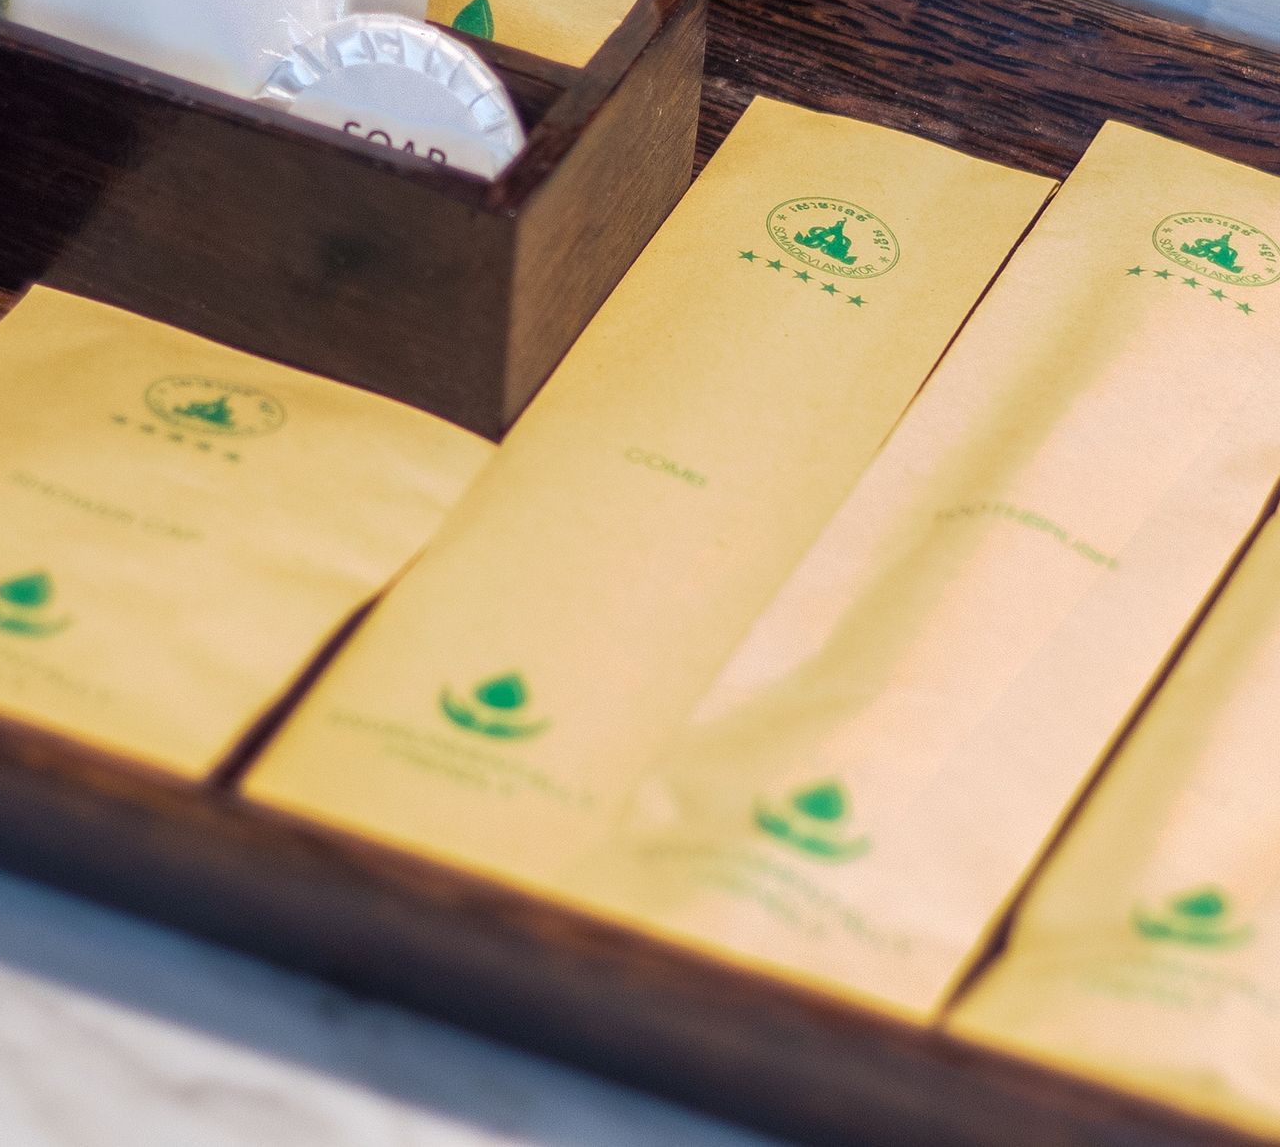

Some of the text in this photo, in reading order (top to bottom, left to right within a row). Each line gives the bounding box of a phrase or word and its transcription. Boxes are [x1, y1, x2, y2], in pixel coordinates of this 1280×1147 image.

[773, 225, 877, 277] SOMADEVI ANGKOR
[1208, 271, 1266, 284] ANGKOR
